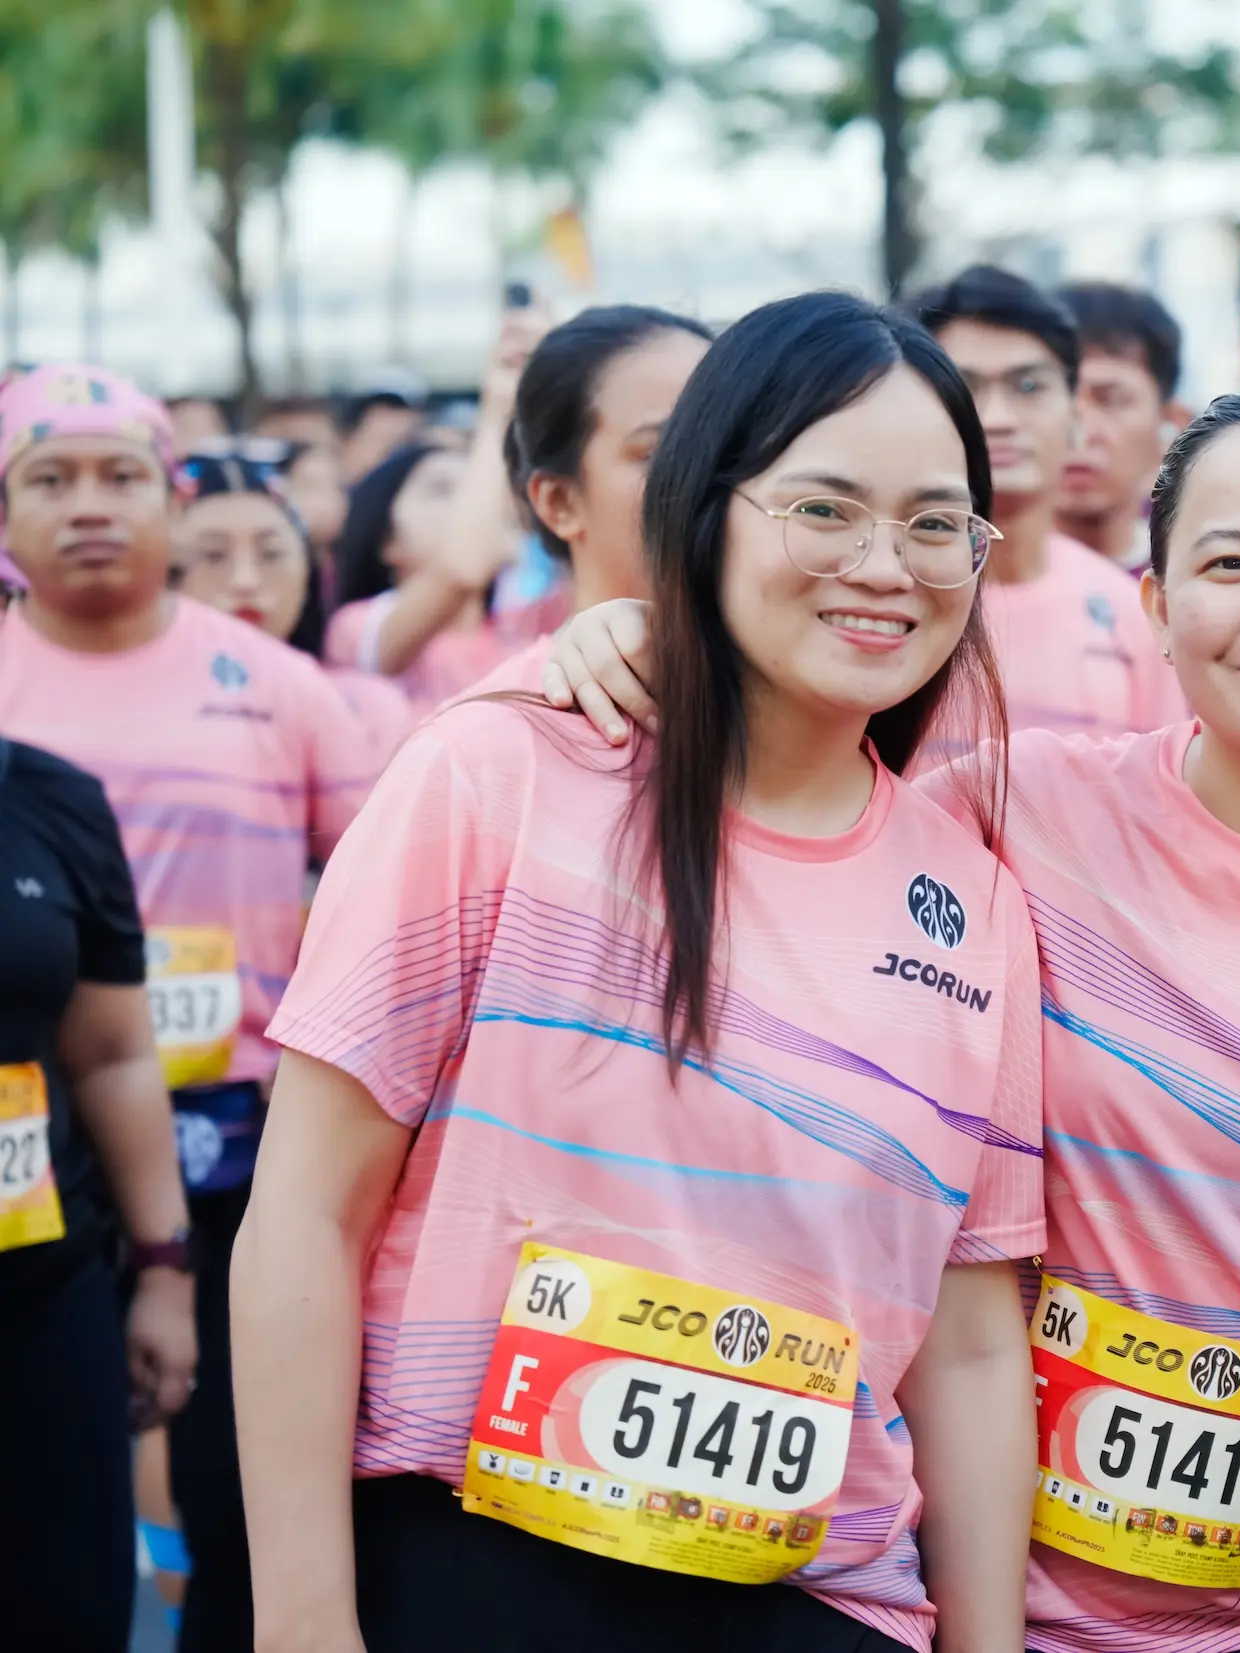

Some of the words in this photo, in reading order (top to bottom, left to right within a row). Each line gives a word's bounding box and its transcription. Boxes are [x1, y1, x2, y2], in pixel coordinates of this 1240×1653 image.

[872, 952, 993, 1013] JCORUN
[526, 1273, 577, 1321] 5K
[618, 1298, 709, 1339] JCO
[775, 1332, 847, 1375] RUN
[1041, 1301, 1078, 1347] 5K
[1106, 1333, 1184, 1373] JCO
[804, 1371, 838, 1394] 2025
[489, 1413, 529, 1437] FEMALE
[501, 1353, 540, 1413] F
[612, 1378, 818, 1495] 51419
